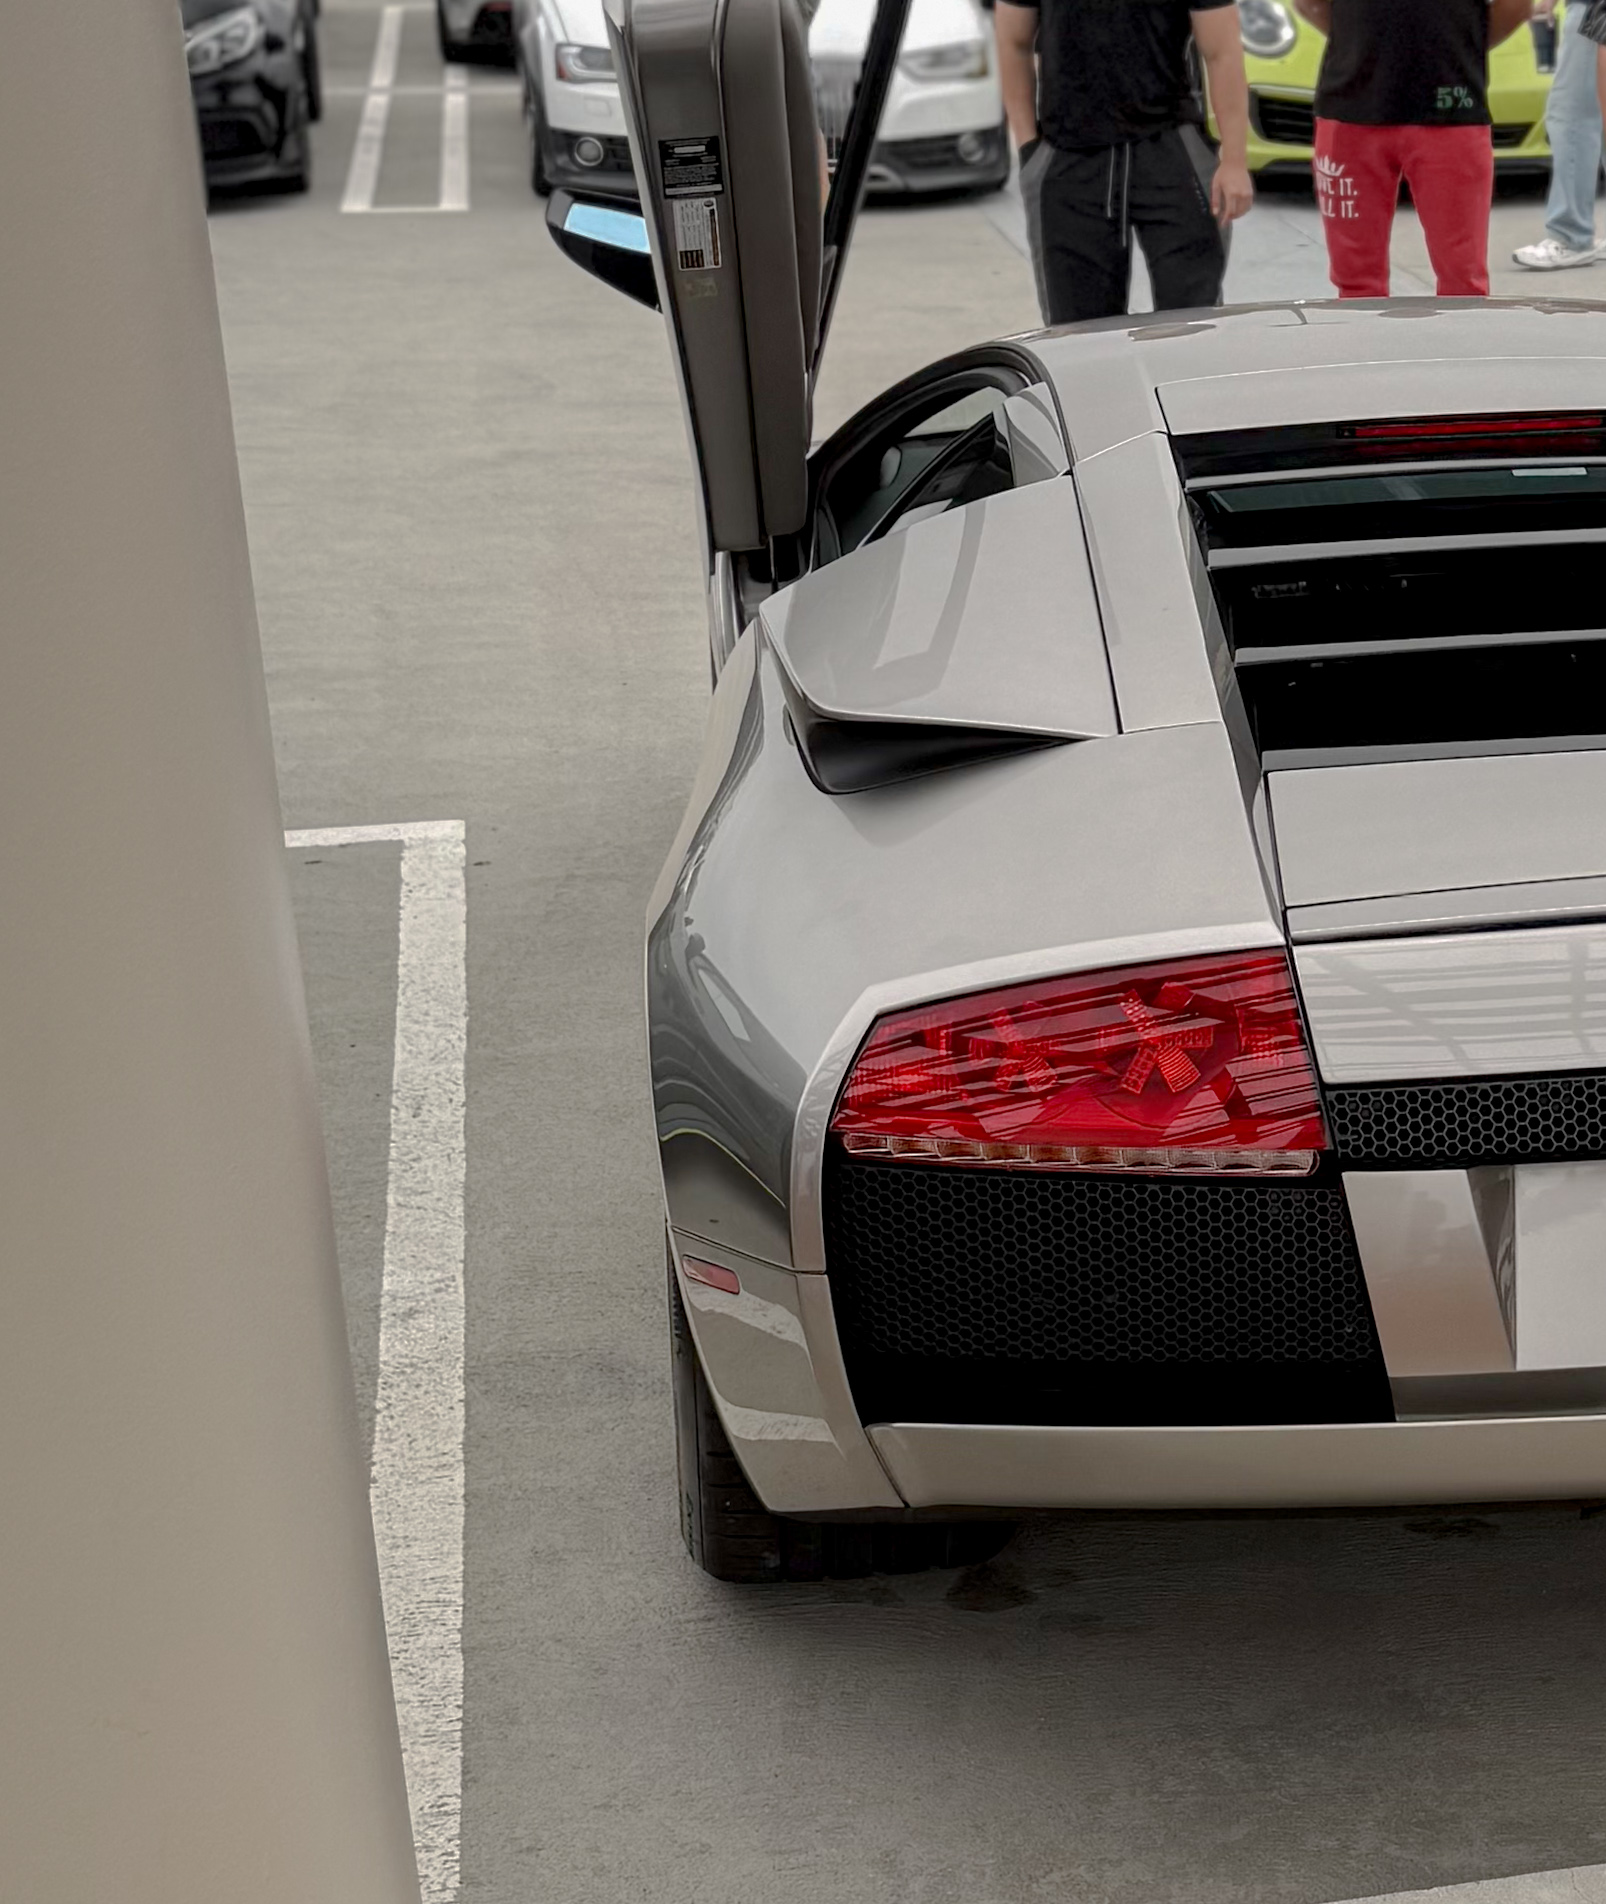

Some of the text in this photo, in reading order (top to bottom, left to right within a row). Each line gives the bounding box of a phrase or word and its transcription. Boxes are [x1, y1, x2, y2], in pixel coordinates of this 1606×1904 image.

[1436, 86, 1474, 109] 5%
[1339, 178, 1358, 197] IT.
[1341, 200, 1359, 218] IT.
